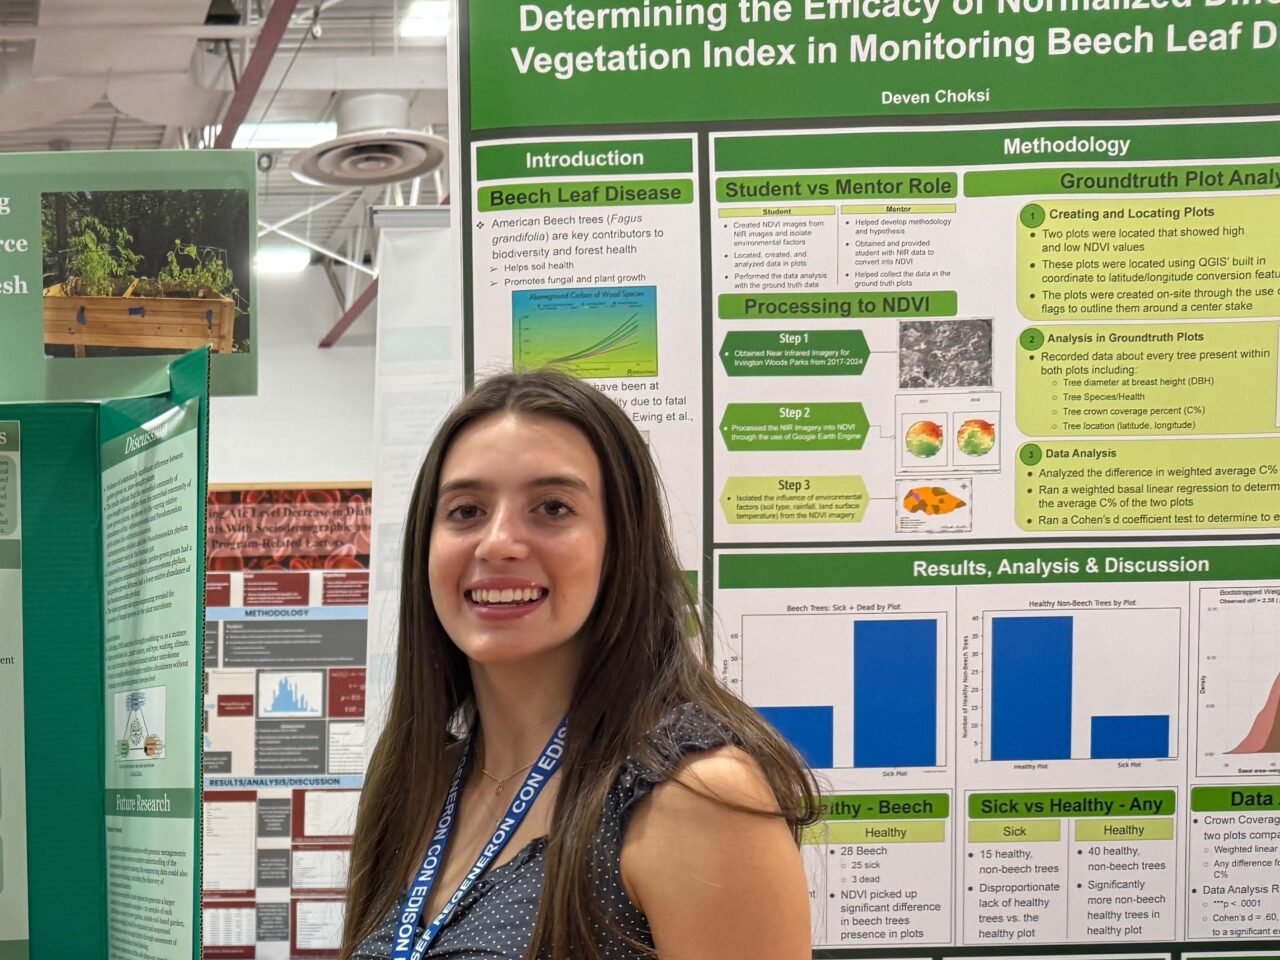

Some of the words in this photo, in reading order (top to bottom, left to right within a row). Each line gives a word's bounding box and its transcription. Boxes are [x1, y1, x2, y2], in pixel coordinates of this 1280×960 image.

[520, 0, 726, 31] Determining
[738, 0, 792, 22] the
[510, 44, 690, 78] Vegetation
[704, 39, 795, 66] Index
[808, 36, 836, 63] in
[850, 31, 1034, 62] Monitoring
[1048, 25, 1152, 54] Beech
[1167, 21, 1242, 51] Leaf
[882, 91, 929, 104] Deven
[934, 88, 989, 102] Choksi
[1004, 136, 1130, 155] Methodology
[526, 150, 643, 167] Introduction
[726, 180, 801, 199] Student
[806, 183, 828, 195] vs
[836, 179, 902, 197] Mentor
[909, 178, 950, 196] Role
[1060, 172, 1177, 192] Groundtruth
[1185, 170, 1223, 190] Plot
[490, 188, 550, 208] Beech
[558, 186, 599, 202] Leaf
[605, 186, 681, 200] Disease
[1049, 208, 1099, 220] Creating
[1102, 208, 1124, 218] and
[1128, 208, 1179, 219] Locating
[1184, 206, 1214, 216] Plots
[745, 298, 851, 316] Processing
[857, 298, 875, 312] to
[882, 297, 930, 313] NDVI
[284, 506, 330, 517] Decrease
[227, 524, 252, 534] With
[306, 538, 344, 547] Factors
[913, 560, 991, 576] Results,
[997, 558, 1079, 577] Analysis
[1085, 557, 1098, 572] &
[1105, 557, 1208, 572] Discussion
[209, 778, 339, 786] RESULTS/ANALYSIS/DISCUSSION
[116, 794, 135, 811] Future
[137, 793, 170, 811] Research
[879, 800, 933, 814] Beech
[981, 799, 1018, 813] Sick
[1024, 802, 1043, 812] vs
[1050, 798, 1113, 818] Healthy
[1128, 797, 1162, 814] Any
[1231, 791, 1272, 808] Data
[433, 817, 516, 926] REGENERON
[512, 772, 544, 814] CON
[419, 844, 441, 882] CON
[396, 886, 427, 951] EDISON
